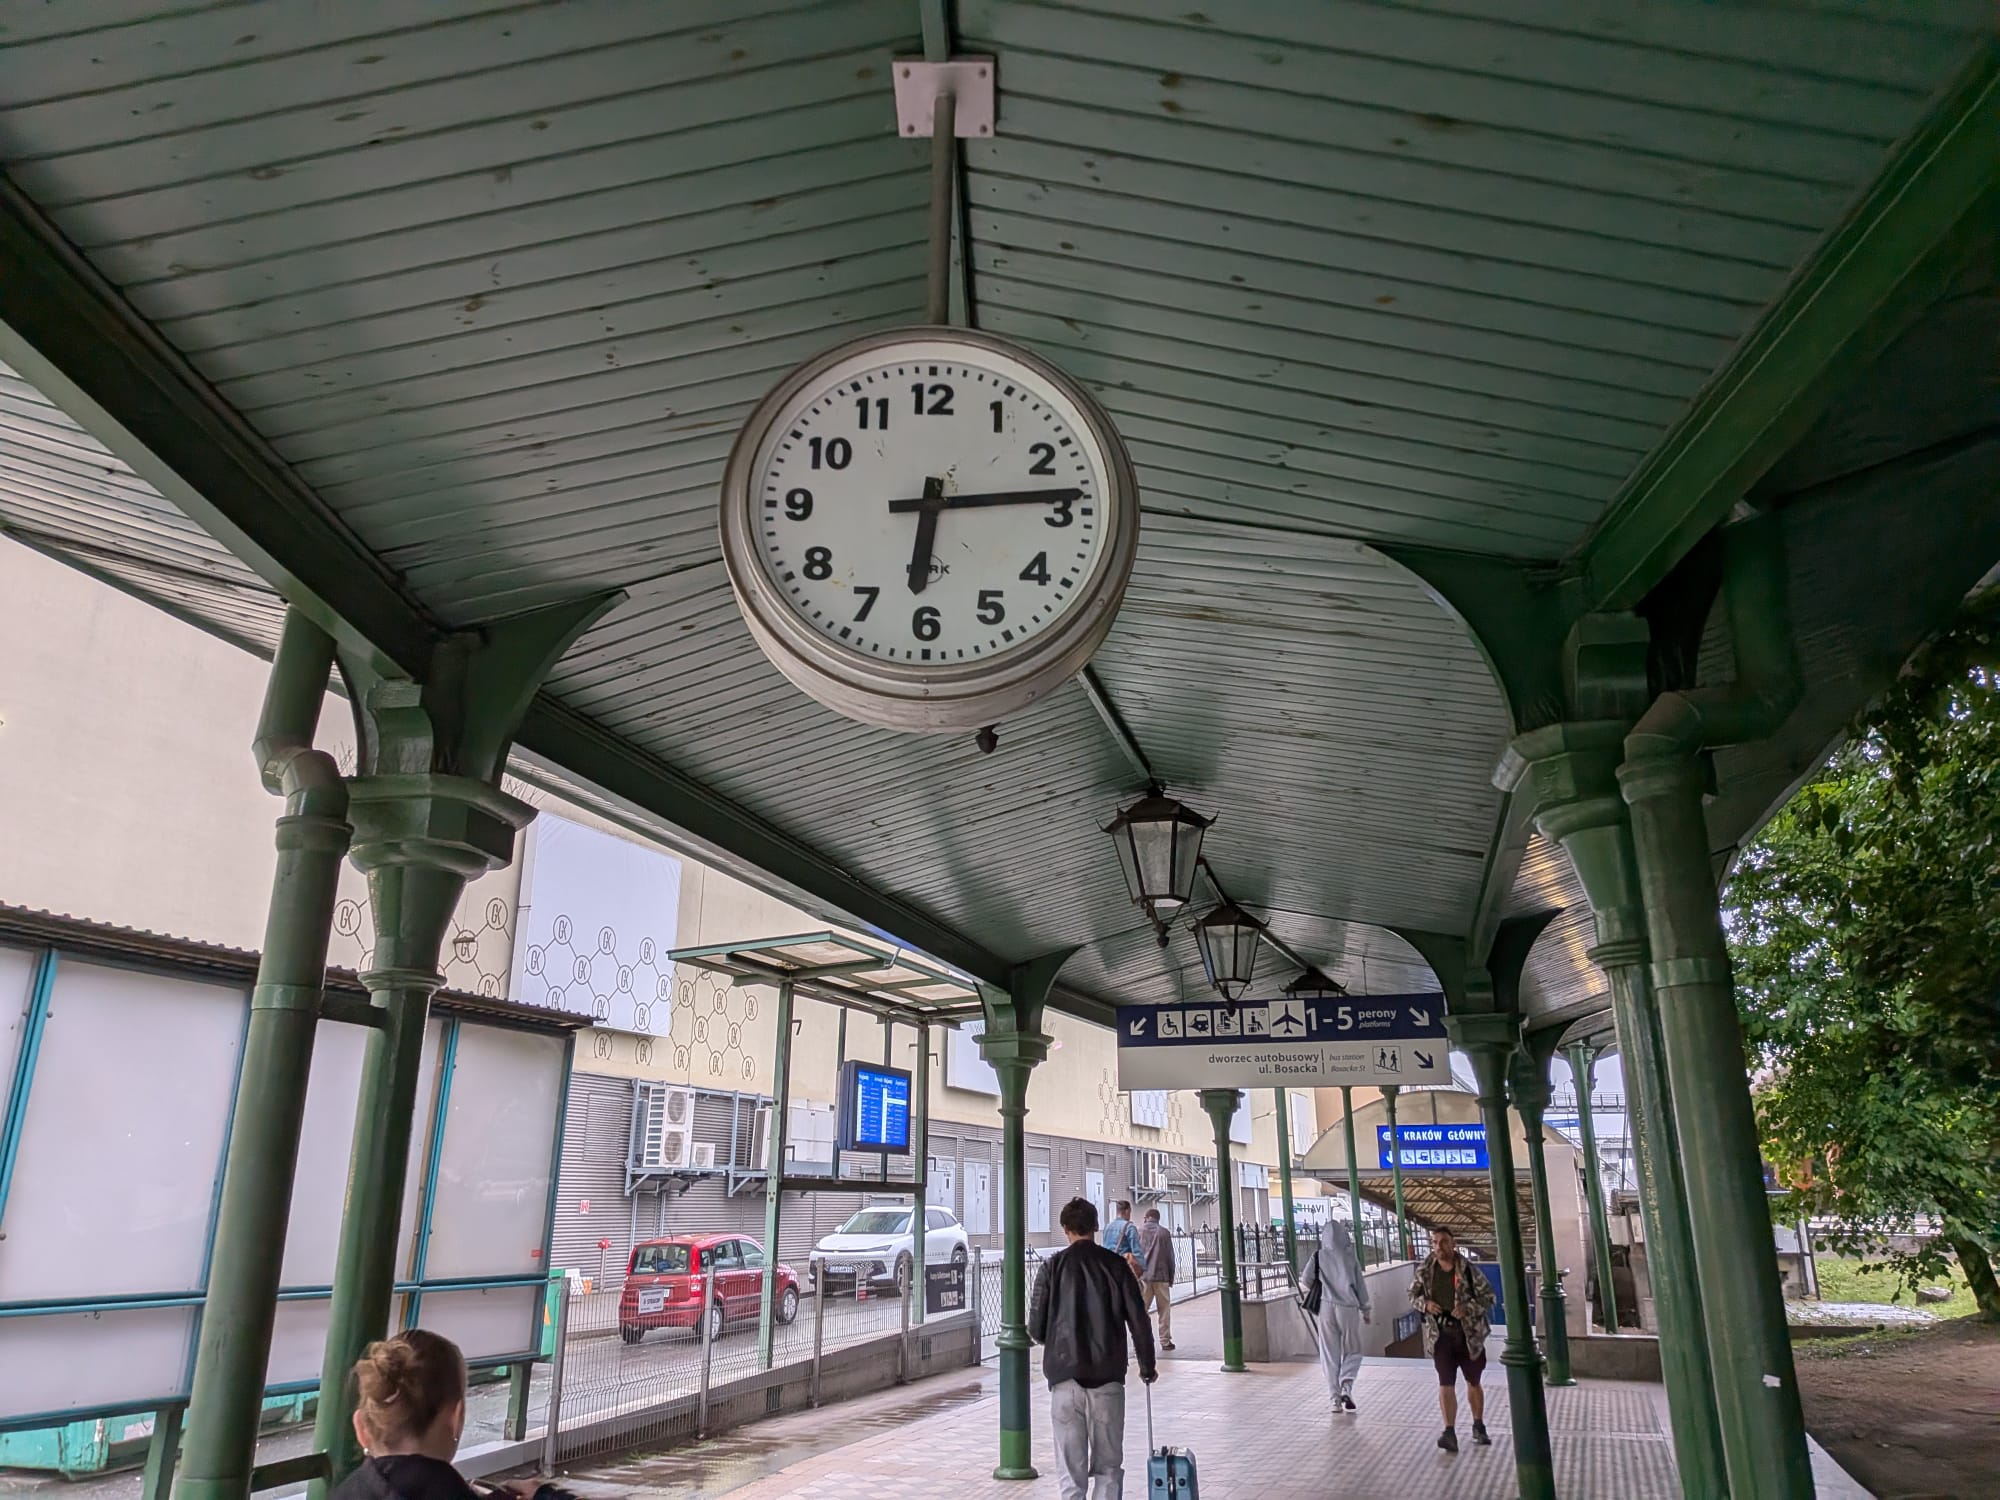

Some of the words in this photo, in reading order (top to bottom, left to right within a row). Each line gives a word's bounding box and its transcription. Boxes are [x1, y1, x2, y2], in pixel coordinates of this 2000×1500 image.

[855, 397, 889, 430] 11
[911, 383, 954, 416] 12
[989, 401, 1003, 433] 1
[808, 436, 852, 470] 10
[1028, 443, 1056, 475] 2
[785, 488, 813, 521] 9
[1044, 497, 1073, 528] 3
[802, 546, 833, 580] 8
[1018, 551, 1051, 586] 4
[853, 586, 880, 622] 7
[975, 590, 1005, 625] 5
[912, 606, 941, 641] 6
[1358, 1009, 1397, 1020] perony
[1358, 1020, 1391, 1029] platforms
[1208, 1053, 1251, 1064] dworzec
[1254, 1052, 1319, 1064] autobusowy
[1258, 1064, 1272, 1074] ul.
[1274, 1063, 1318, 1074] Bosacka
[1403, 1129, 1442, 1141] KRAKÓW
[1447, 1128, 1486, 1140] GŁÓWNY
[1303, 1204, 1324, 1214] HAVI
